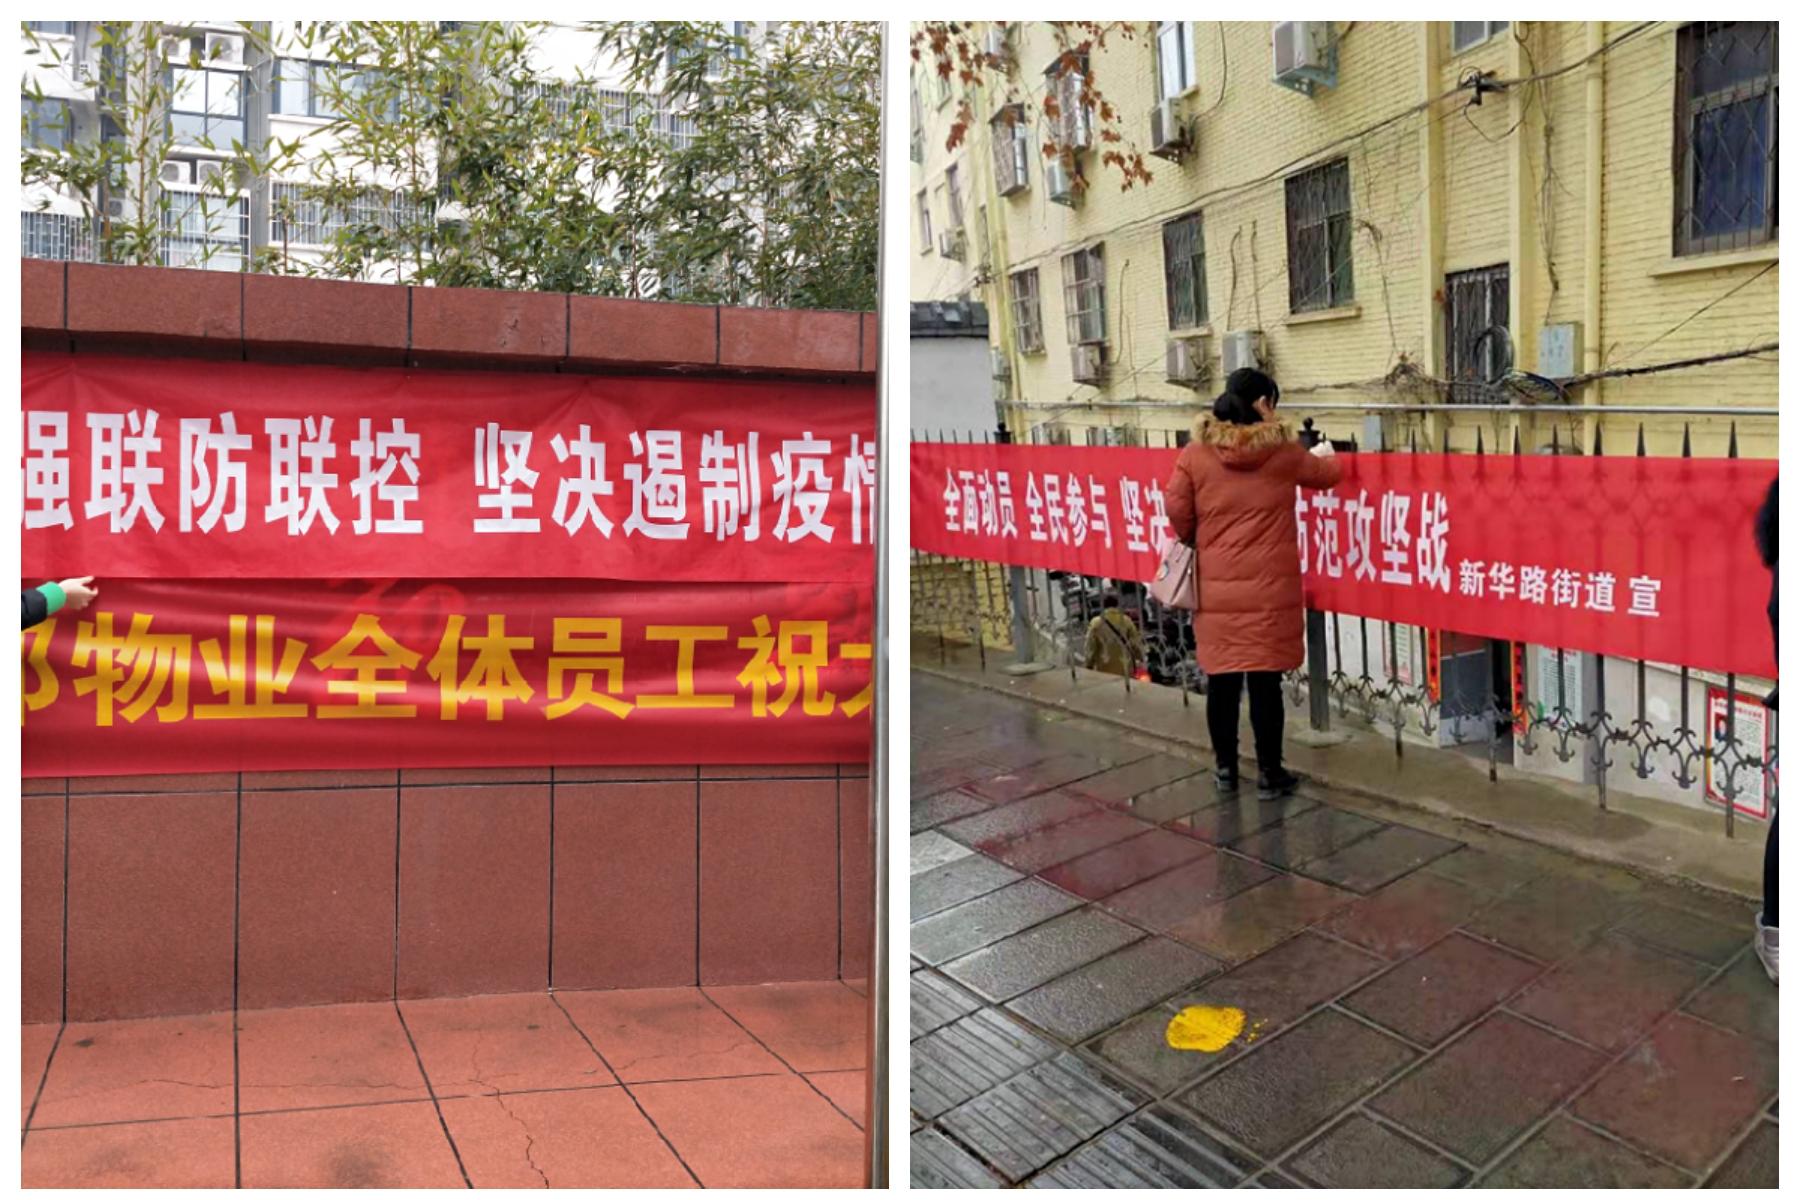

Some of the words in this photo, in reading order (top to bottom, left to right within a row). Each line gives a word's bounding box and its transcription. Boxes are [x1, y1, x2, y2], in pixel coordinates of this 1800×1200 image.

[21, 410, 423, 535] 强联防联控
[943, 470, 1018, 537] 全面动员
[1025, 471, 1112, 549] 全民参与
[1459, 559, 1616, 612] 新华路街道
[1627, 576, 1661, 617] 宣
